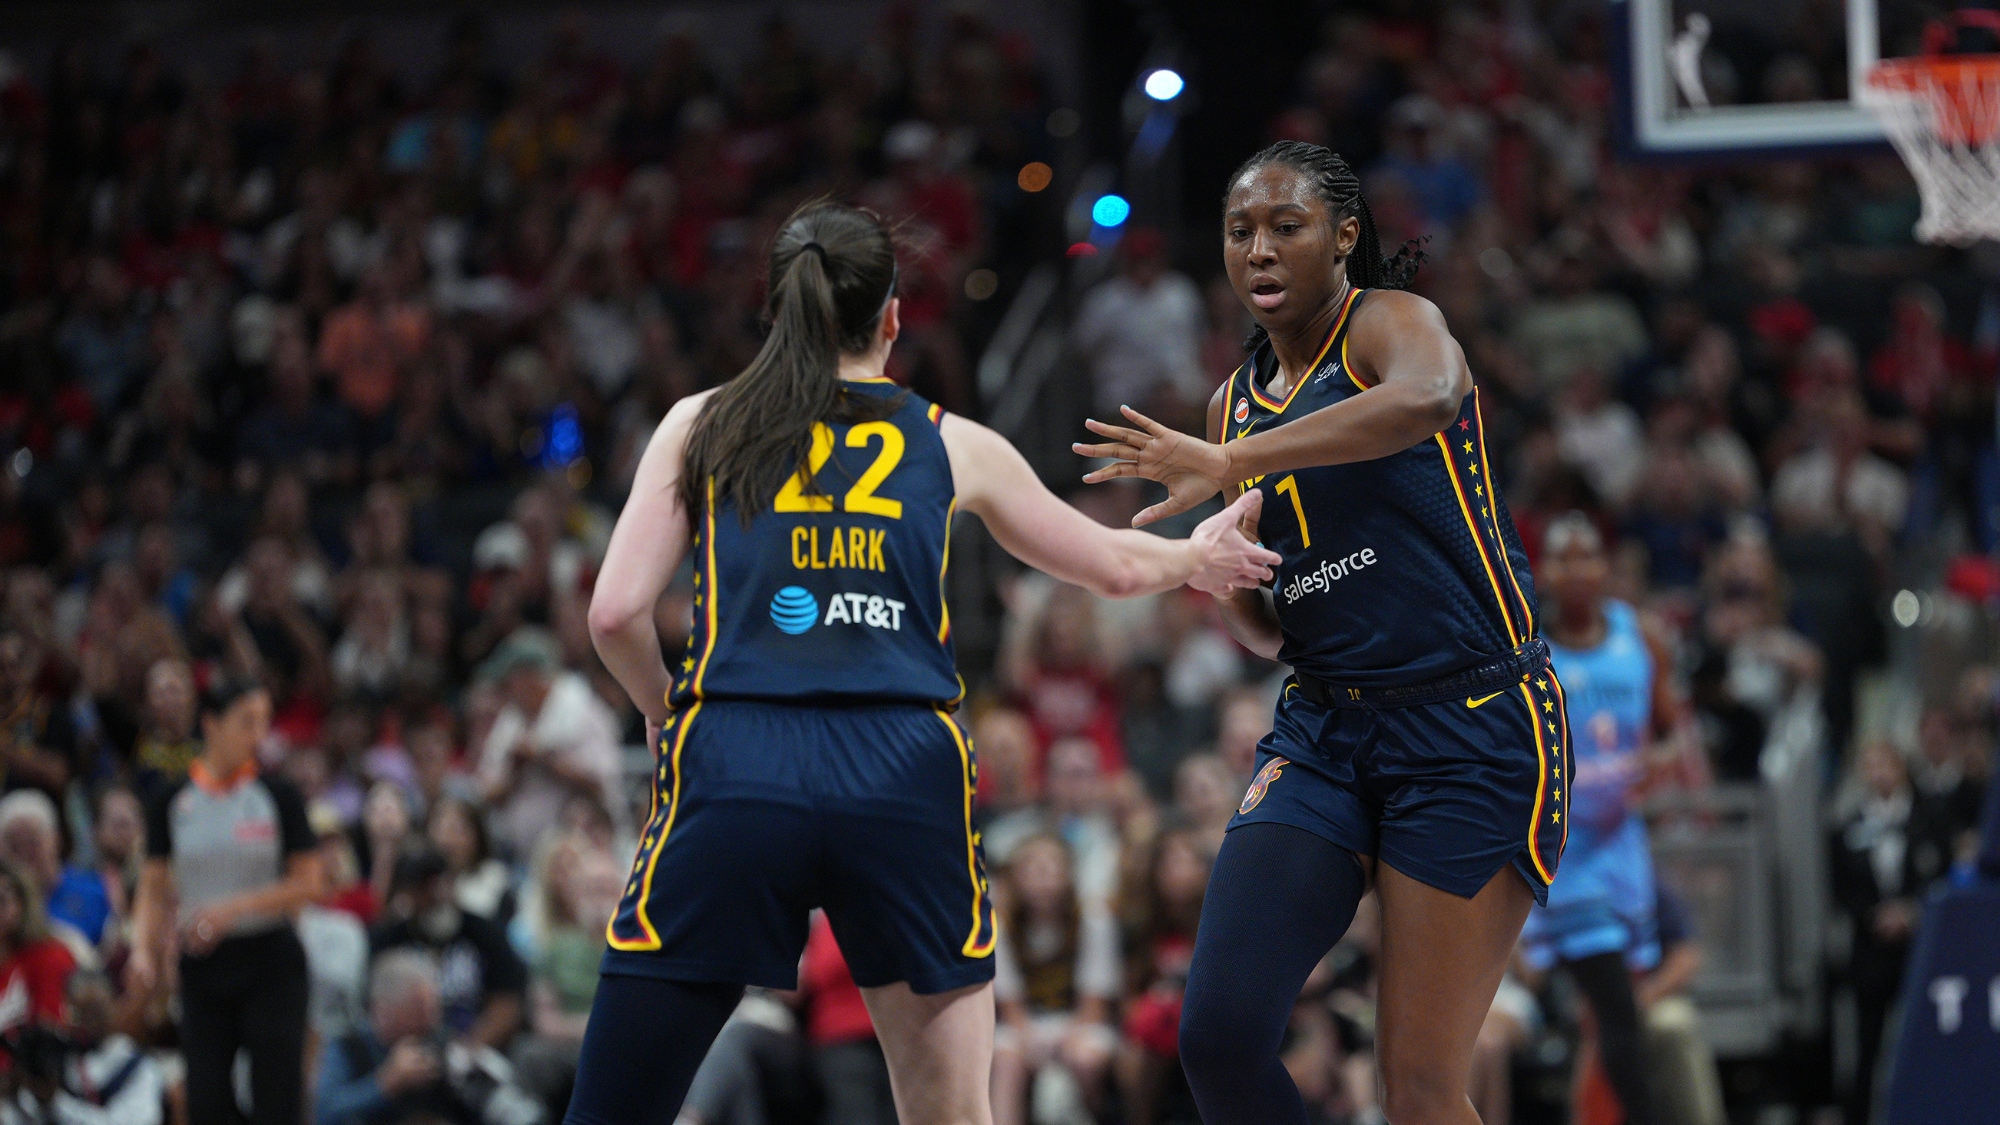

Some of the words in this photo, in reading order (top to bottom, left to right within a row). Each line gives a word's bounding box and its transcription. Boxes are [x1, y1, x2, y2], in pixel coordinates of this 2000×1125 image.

[774, 420, 905, 520] 22
[1274, 473, 1311, 549] 7
[791, 525, 886, 573] CLARK
[1283, 547, 1377, 604] salesforce
[824, 592, 906, 631] AT&T
